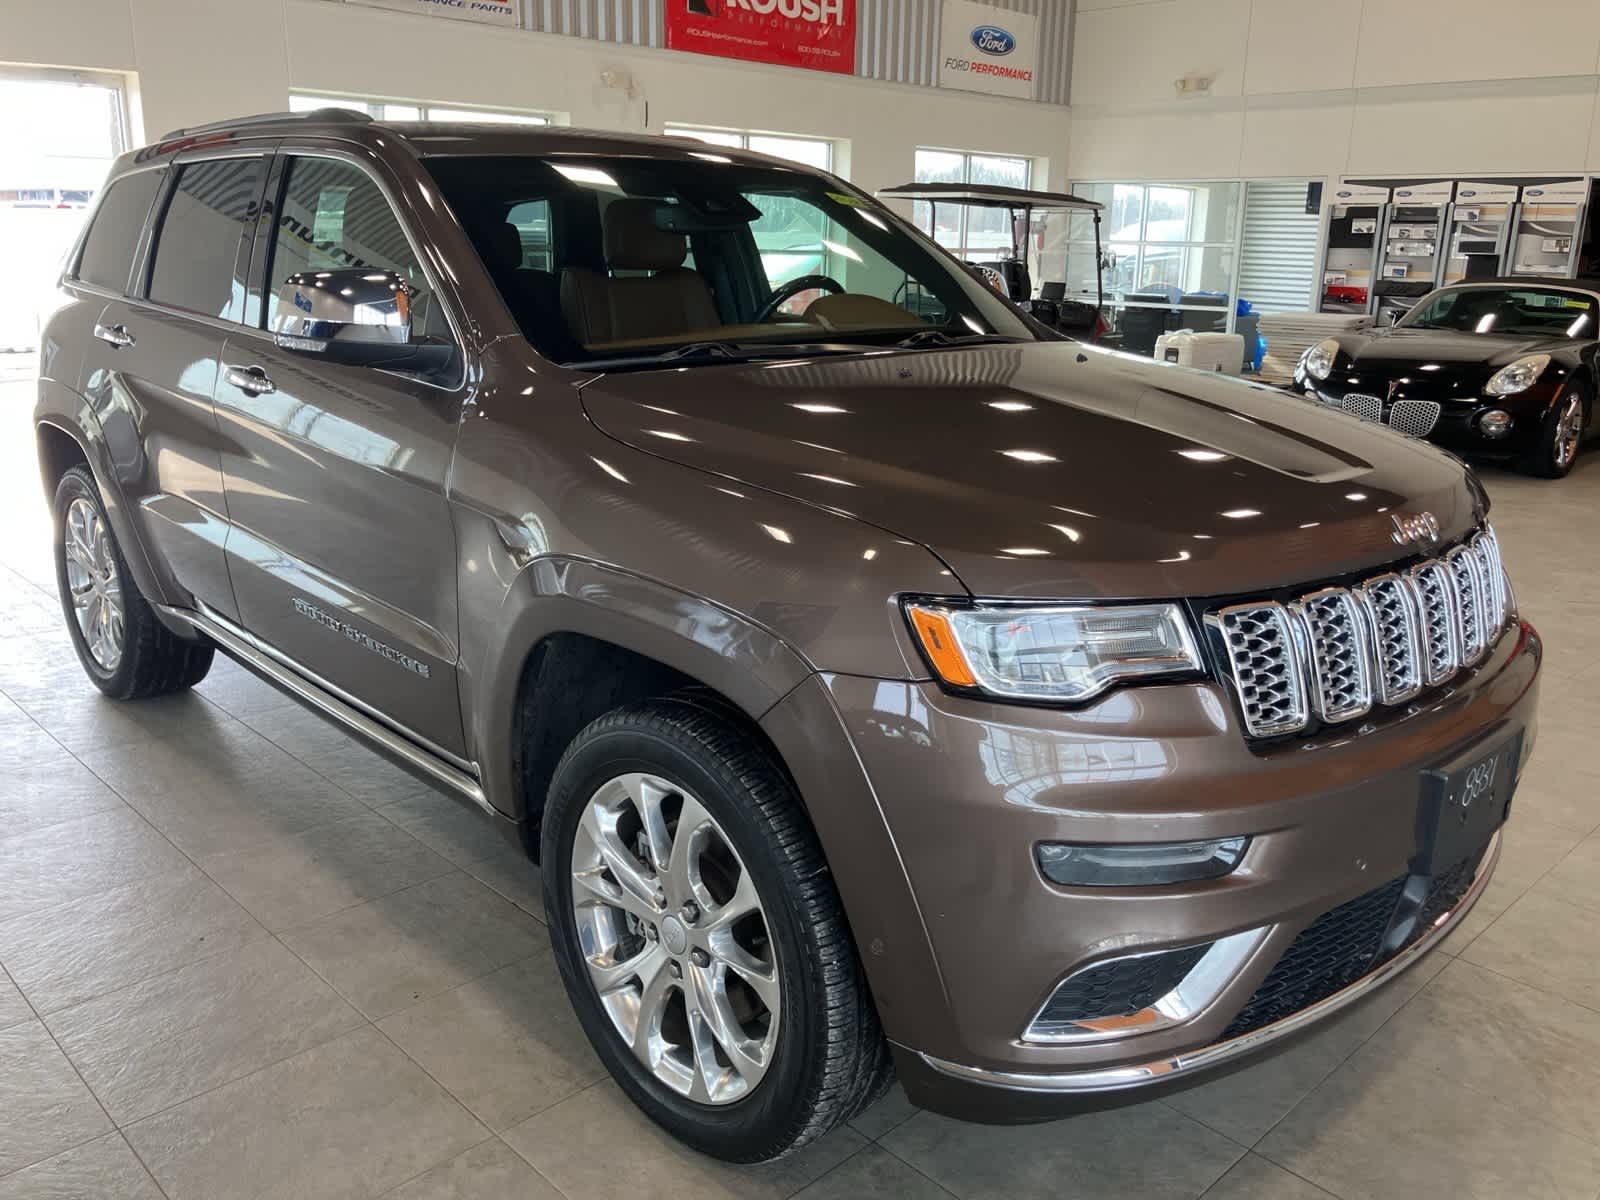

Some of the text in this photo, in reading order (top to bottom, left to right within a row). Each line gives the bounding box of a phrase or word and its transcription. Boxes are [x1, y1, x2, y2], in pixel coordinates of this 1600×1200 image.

[471, 2, 513, 15] PARTS
[726, 0, 843, 26] OUSH
[978, 29, 1007, 52] Ford
[945, 58, 1032, 81] FORD PERFORMANCE
[1391, 511, 1440, 546] Jeep
